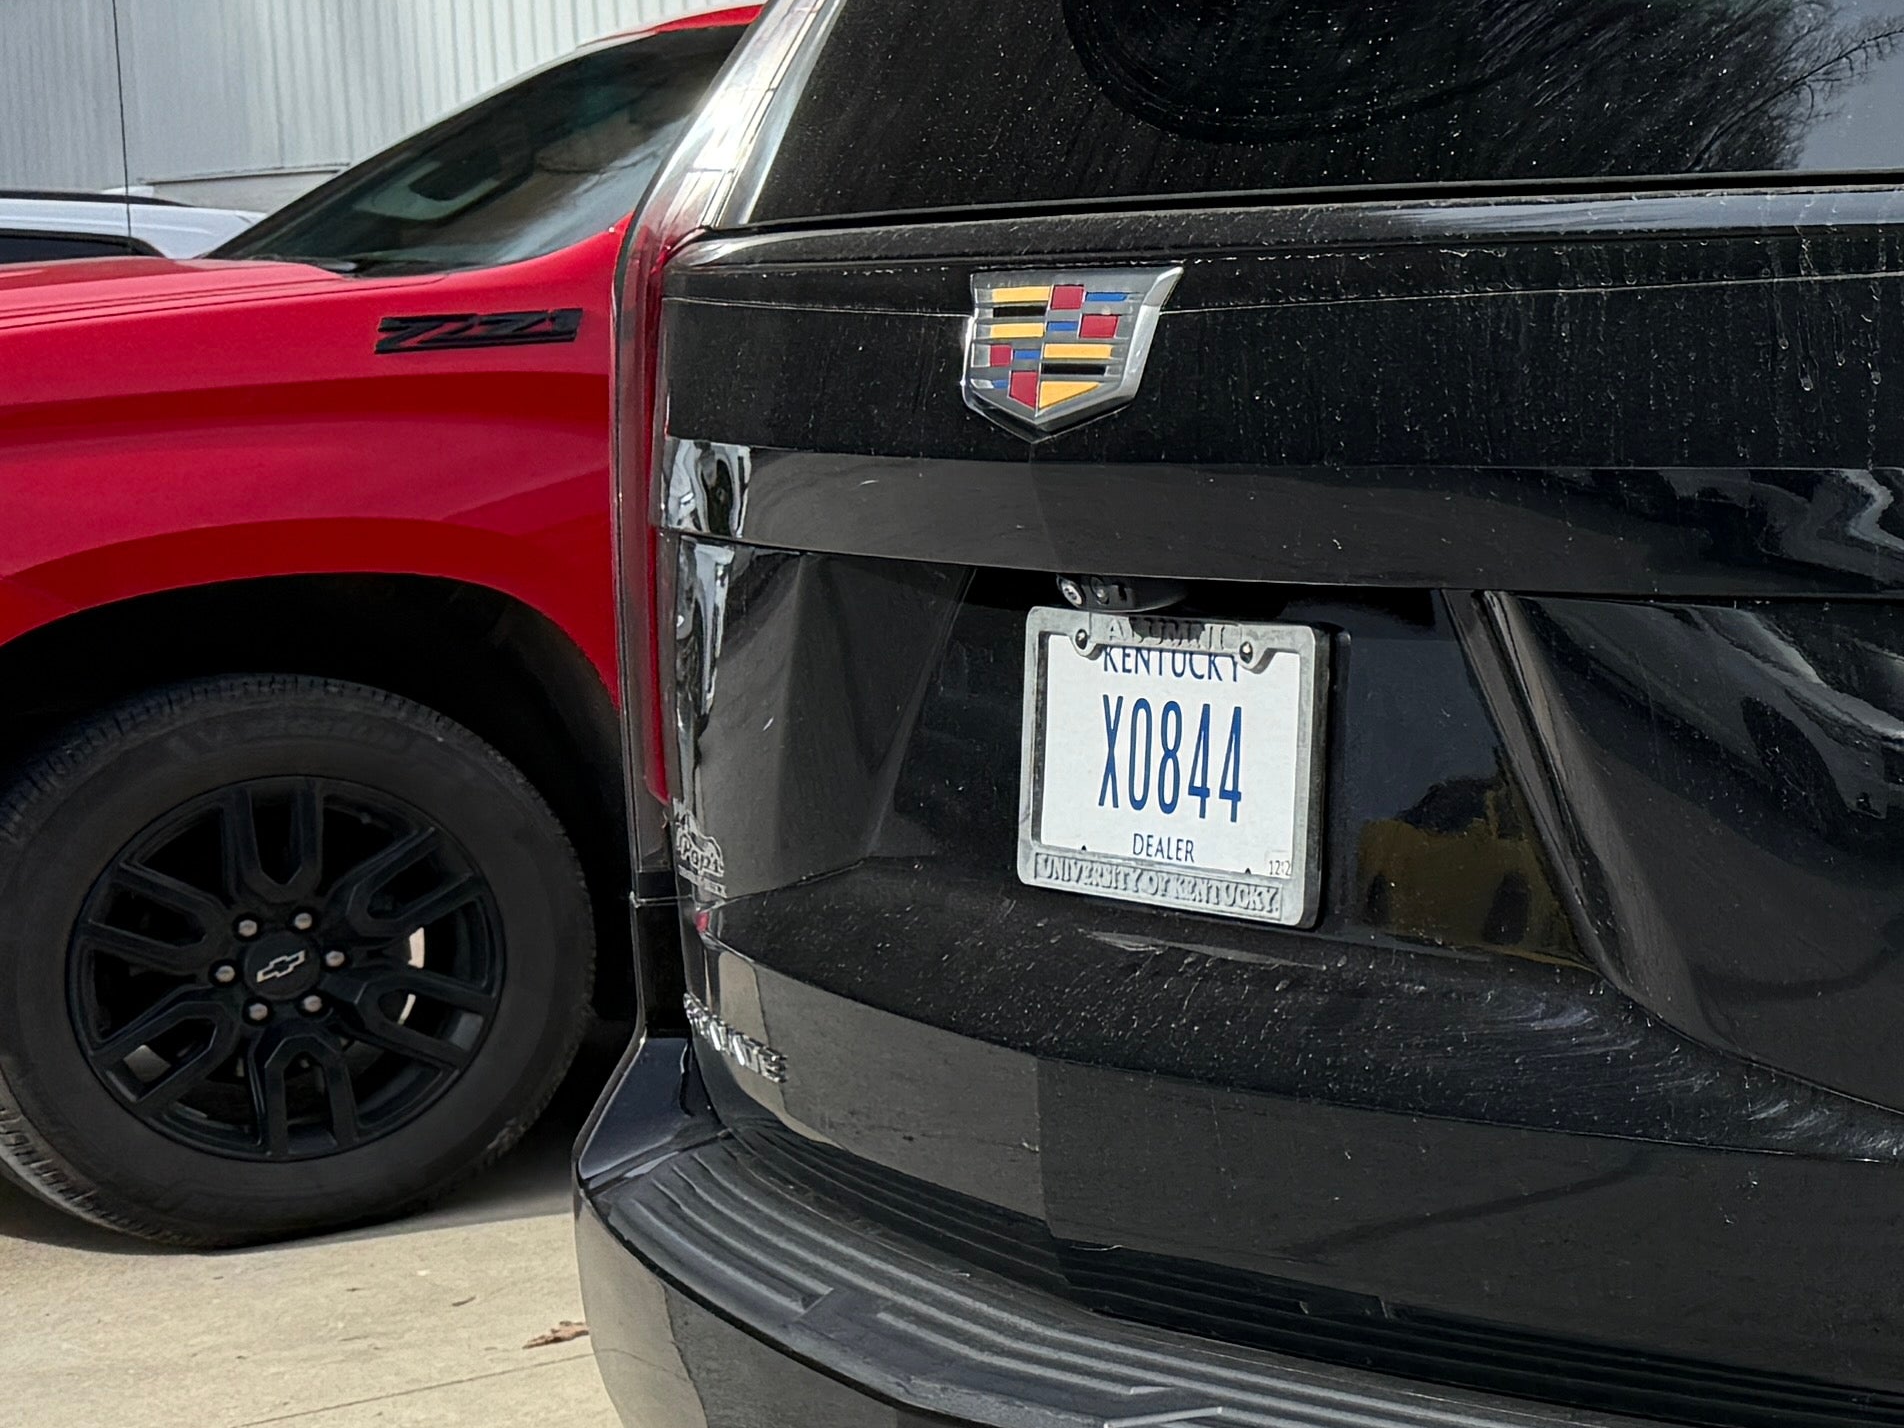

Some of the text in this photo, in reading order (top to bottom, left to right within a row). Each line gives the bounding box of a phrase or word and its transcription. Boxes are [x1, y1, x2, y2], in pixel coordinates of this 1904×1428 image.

[1097, 693, 1243, 823] X0844
[1131, 832, 1195, 863] DEALER
[1036, 853, 1143, 893] UNIVERSITY
